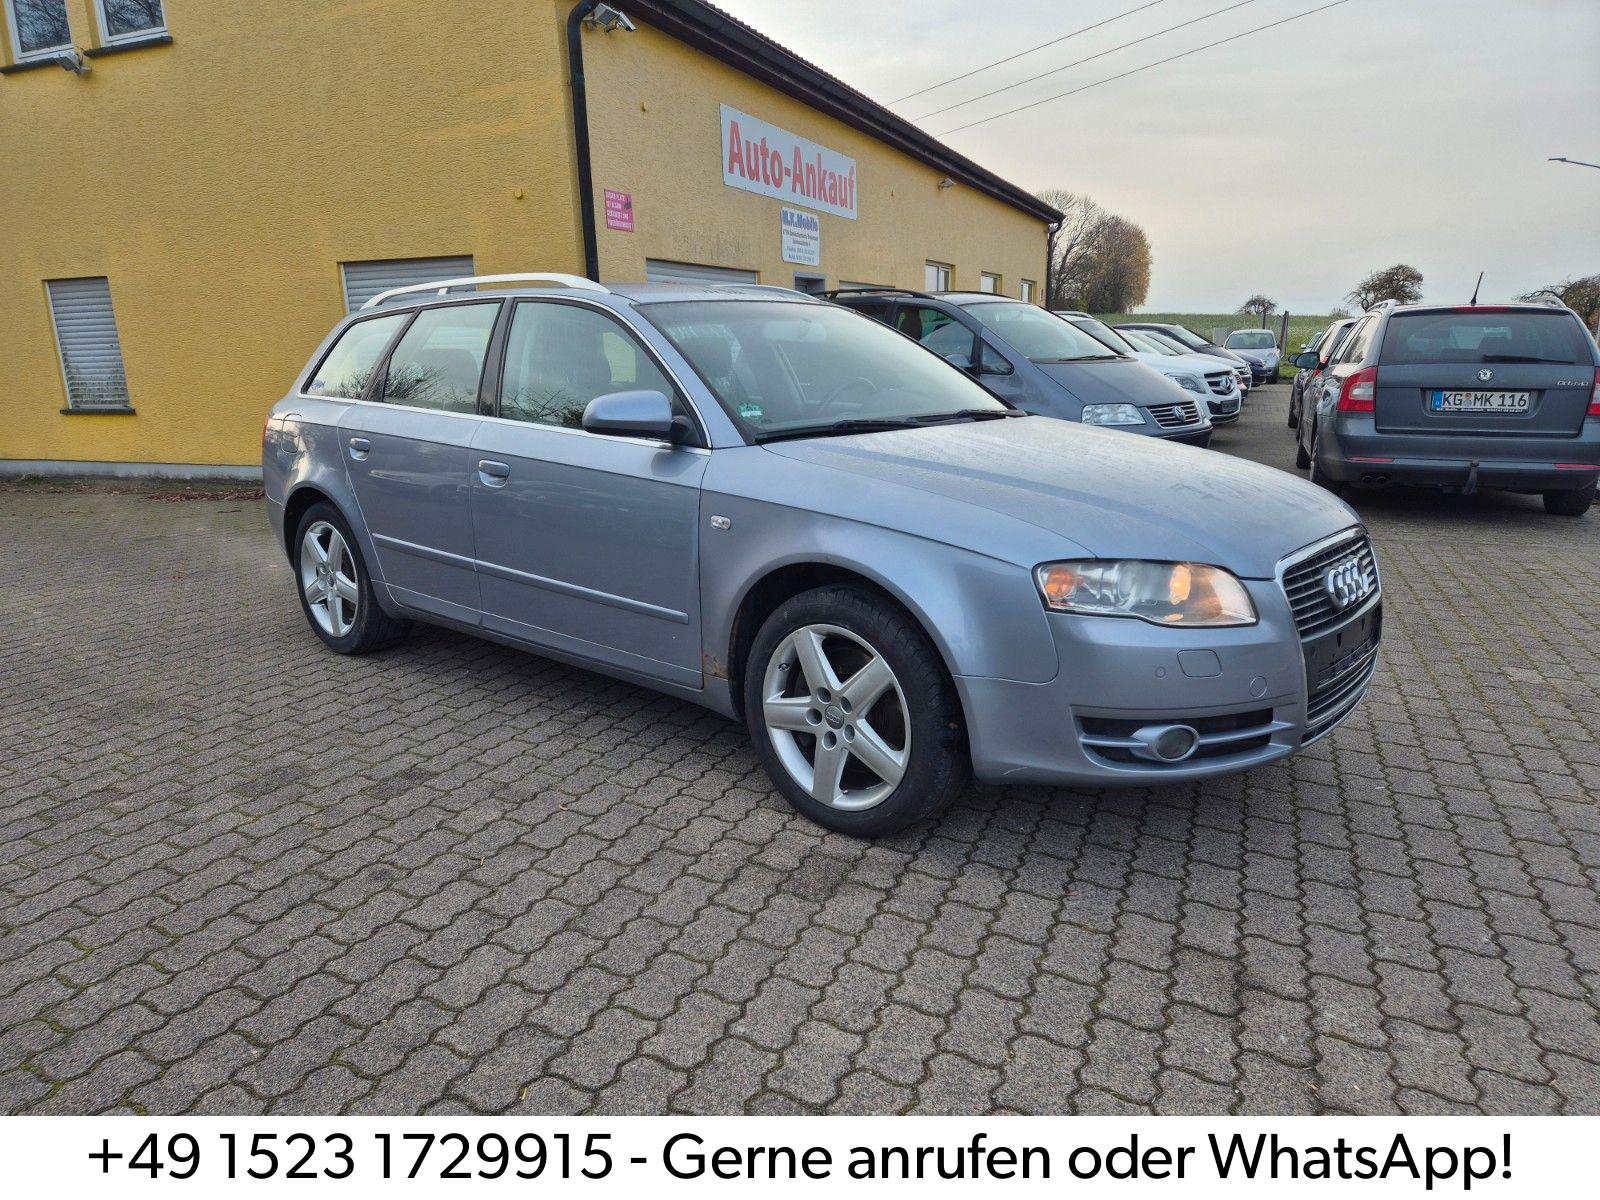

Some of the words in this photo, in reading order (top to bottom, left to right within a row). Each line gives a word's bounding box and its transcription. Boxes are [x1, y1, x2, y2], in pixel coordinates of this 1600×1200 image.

[728, 120, 855, 210] Auto-Ankauf
[1443, 393, 1463, 406] KG
[1473, 393, 1493, 407] MK
[1497, 393, 1527, 408] 116
